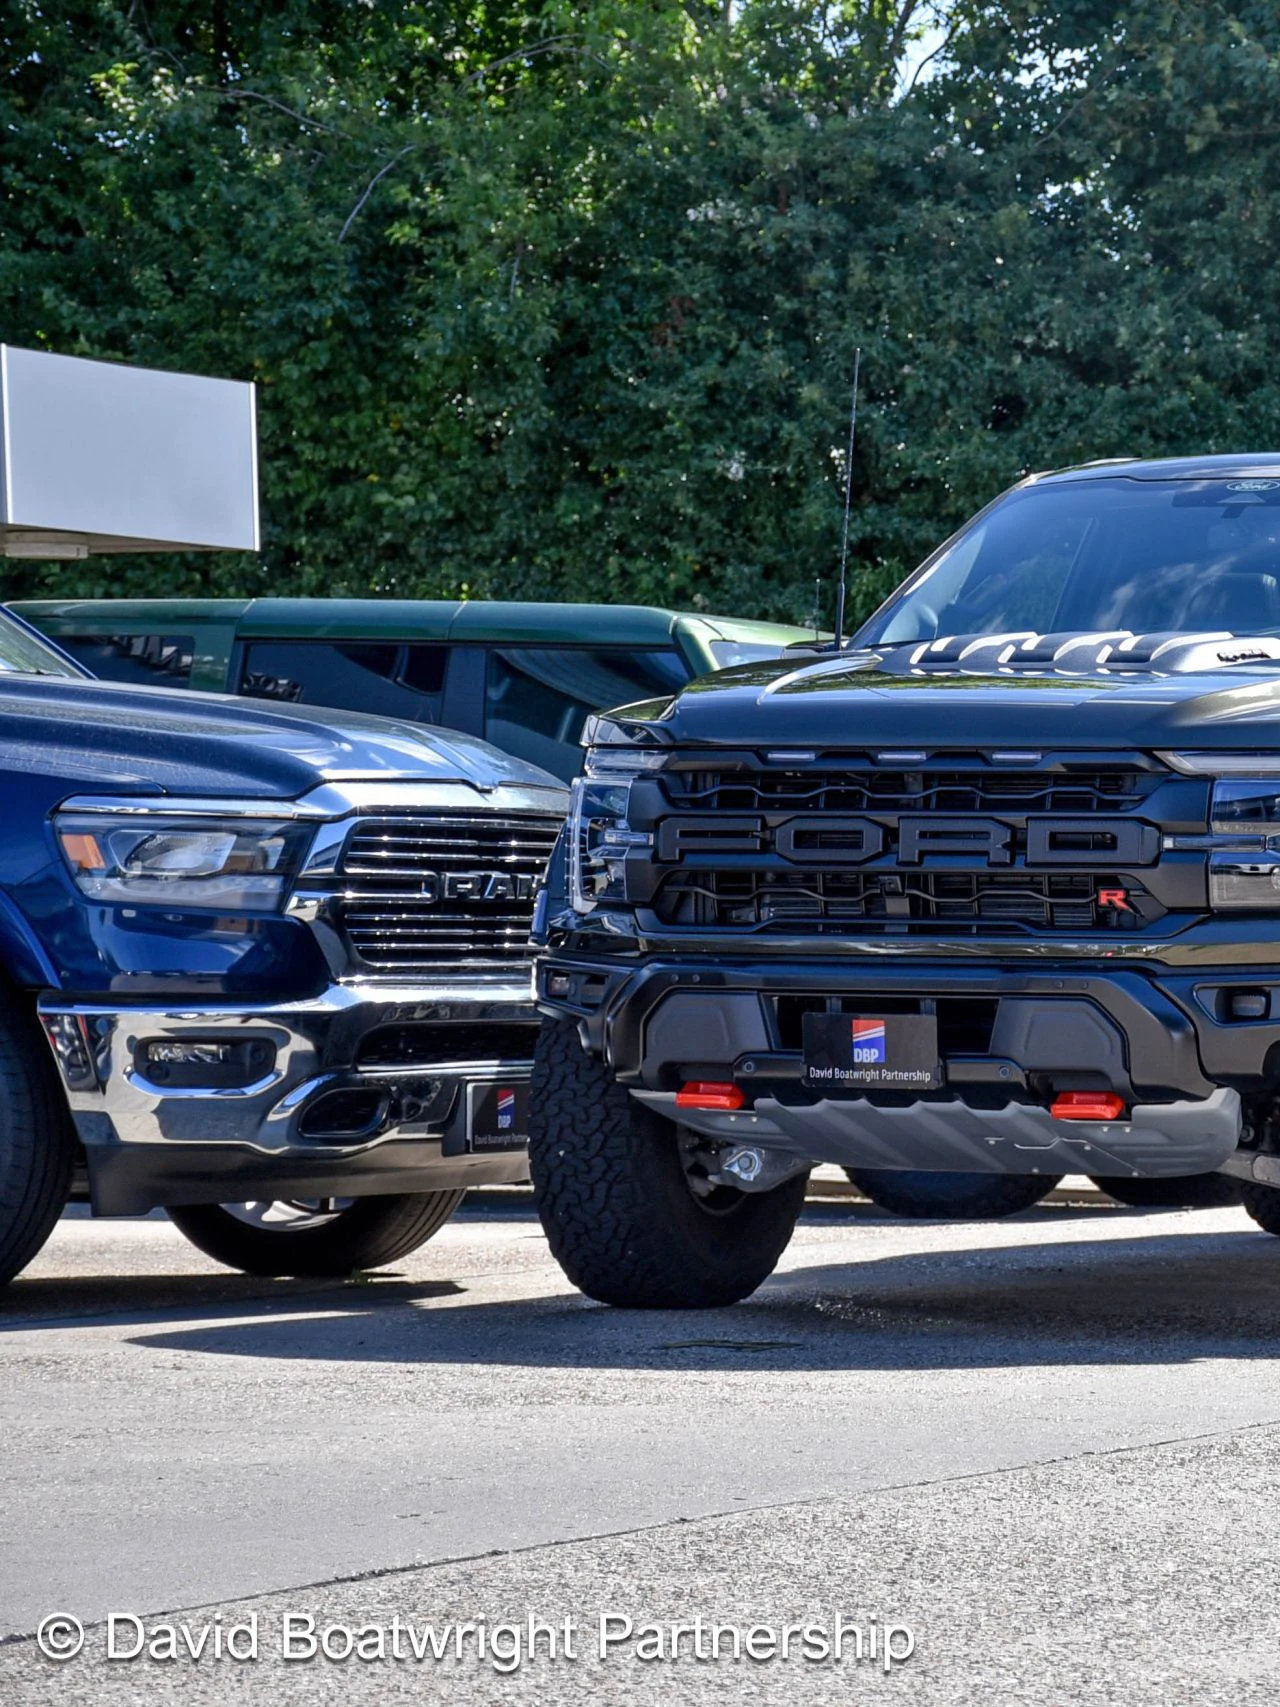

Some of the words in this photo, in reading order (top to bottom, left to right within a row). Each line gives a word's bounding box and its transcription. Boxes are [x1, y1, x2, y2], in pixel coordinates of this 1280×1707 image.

[655, 814, 1160, 867] FORD
[1098, 888, 1132, 911] R
[853, 1047, 879, 1063] DBP
[809, 1066, 833, 1079] David
[834, 1067, 880, 1082] Boatwright
[881, 1069, 931, 1083] Partnership
